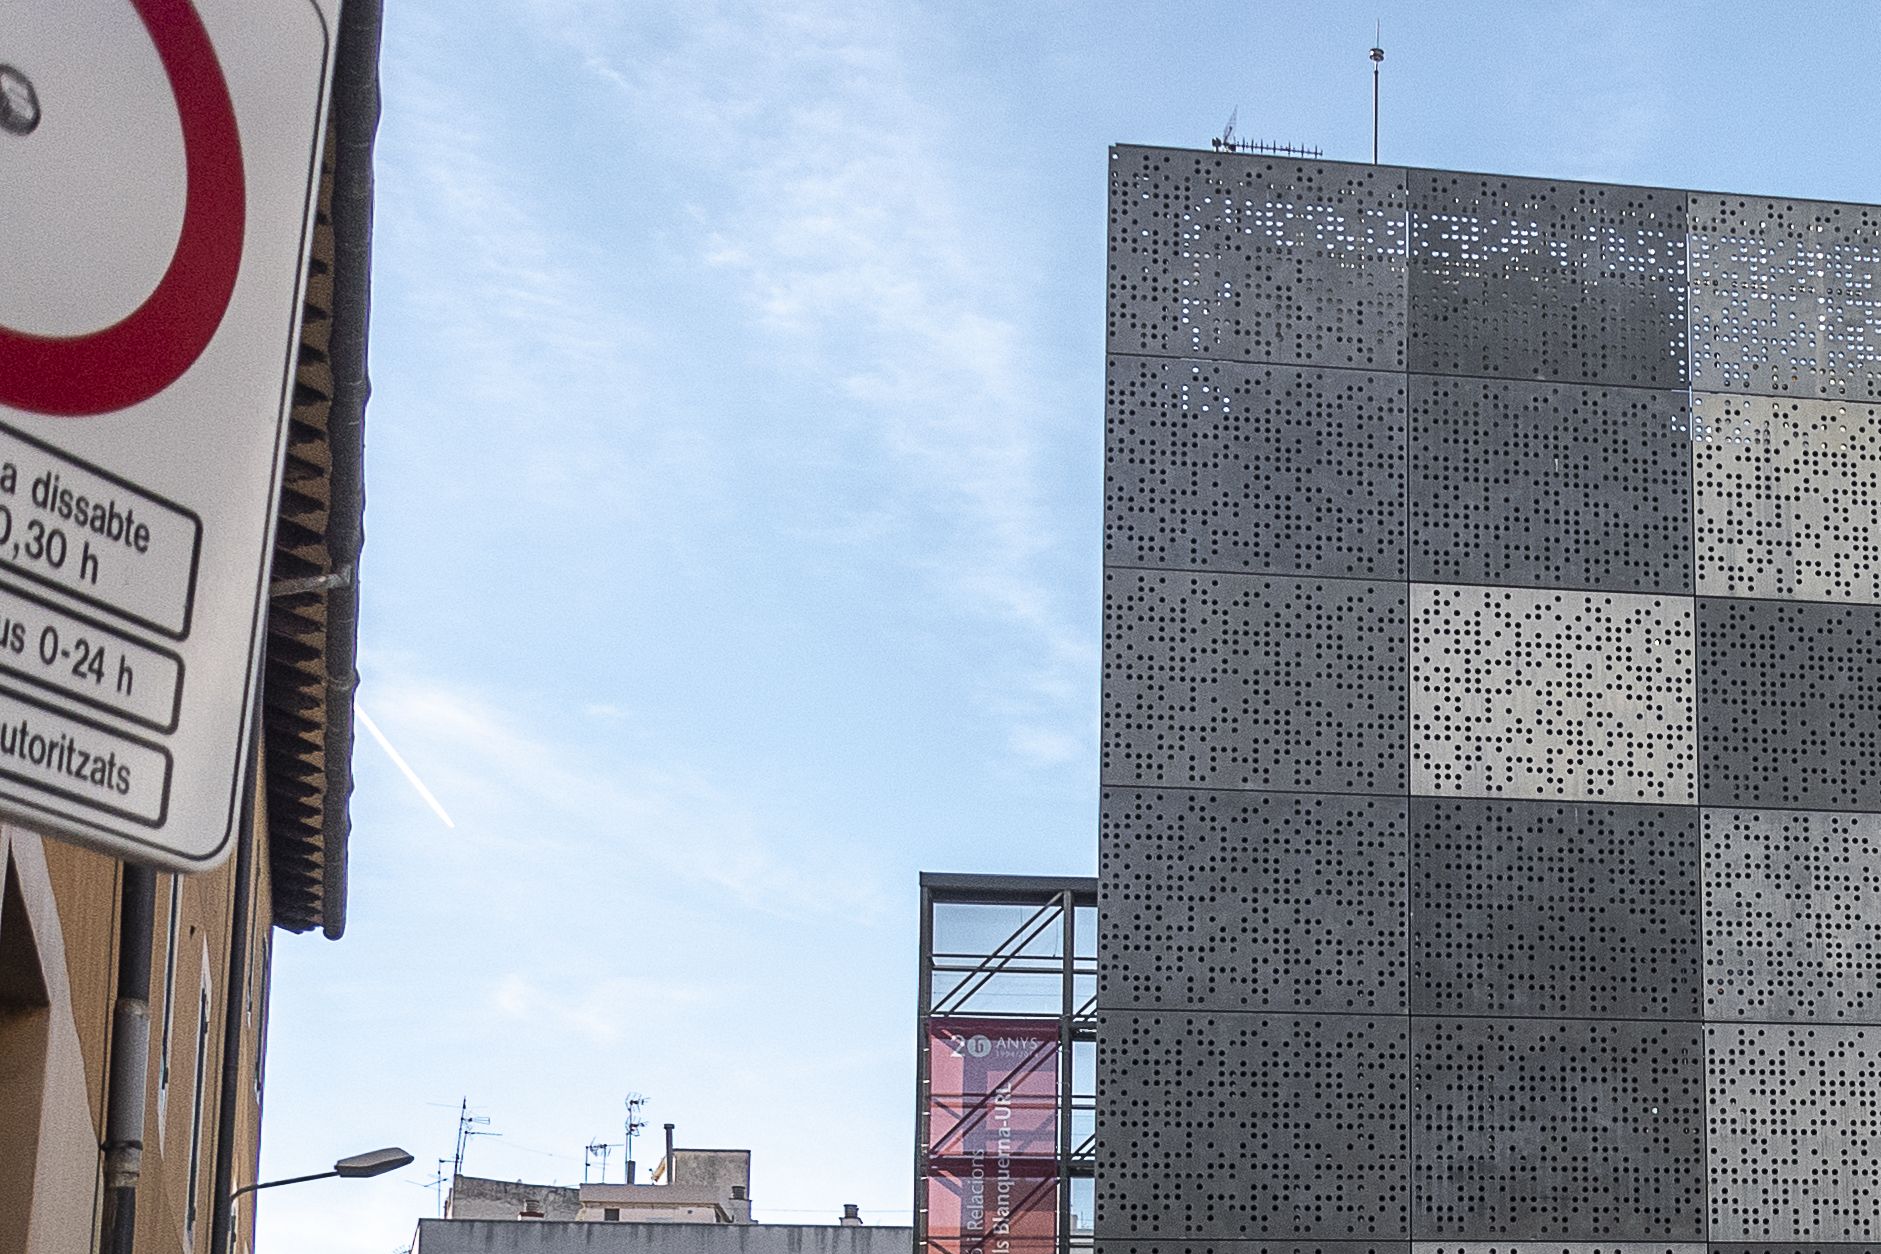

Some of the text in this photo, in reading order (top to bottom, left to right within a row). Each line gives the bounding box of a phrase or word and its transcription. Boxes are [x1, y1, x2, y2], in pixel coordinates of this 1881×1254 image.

[31, 470, 151, 555] dissabte
[80, 540, 99, 586] h
[39, 624, 106, 685] 0-24
[117, 653, 134, 697] h
[967, 1148, 986, 1231] Relacions
